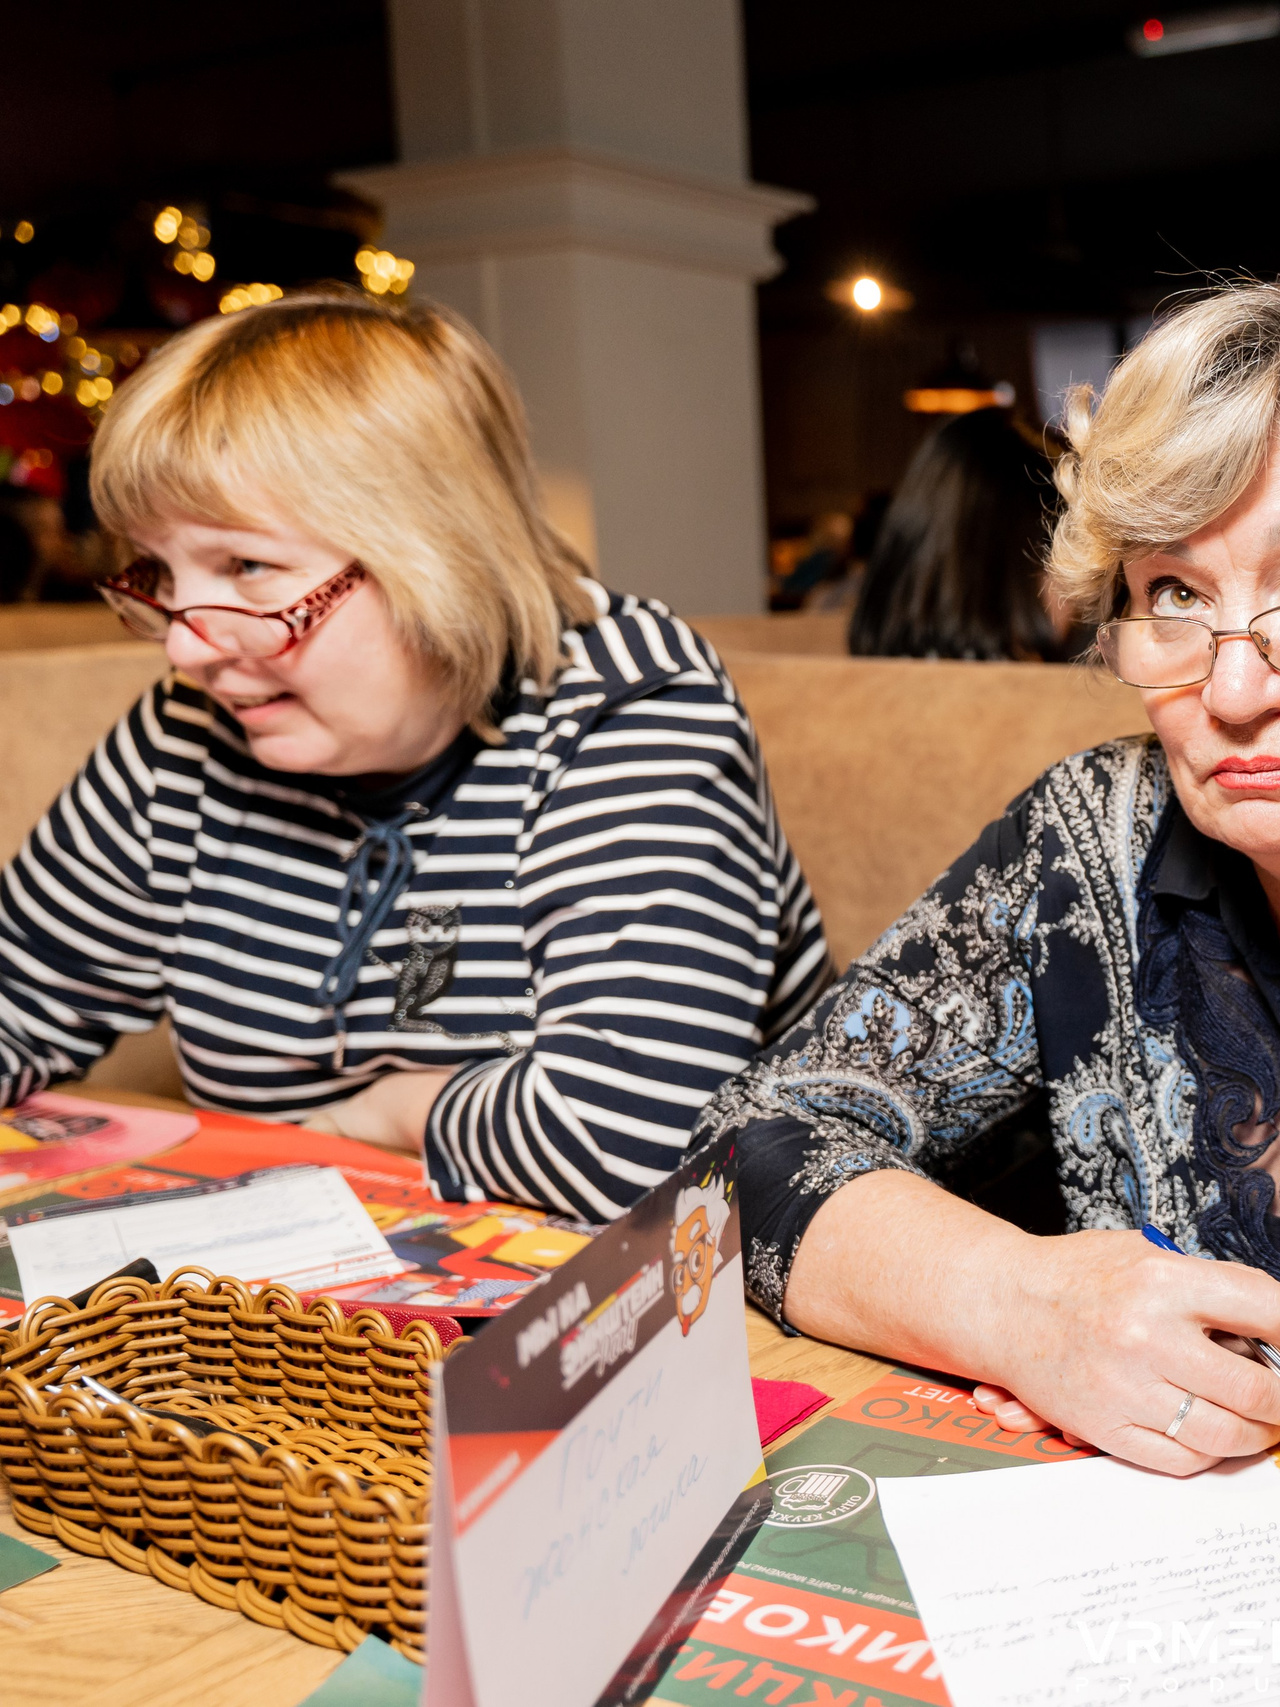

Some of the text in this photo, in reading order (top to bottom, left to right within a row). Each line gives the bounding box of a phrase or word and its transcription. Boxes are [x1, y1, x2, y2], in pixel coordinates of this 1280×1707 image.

[903, 1385, 959, 1404] ЛЕТ
[768, 1495, 862, 1524] ОДНА КРУЖК
[702, 1588, 944, 1680] ИКОЕ
